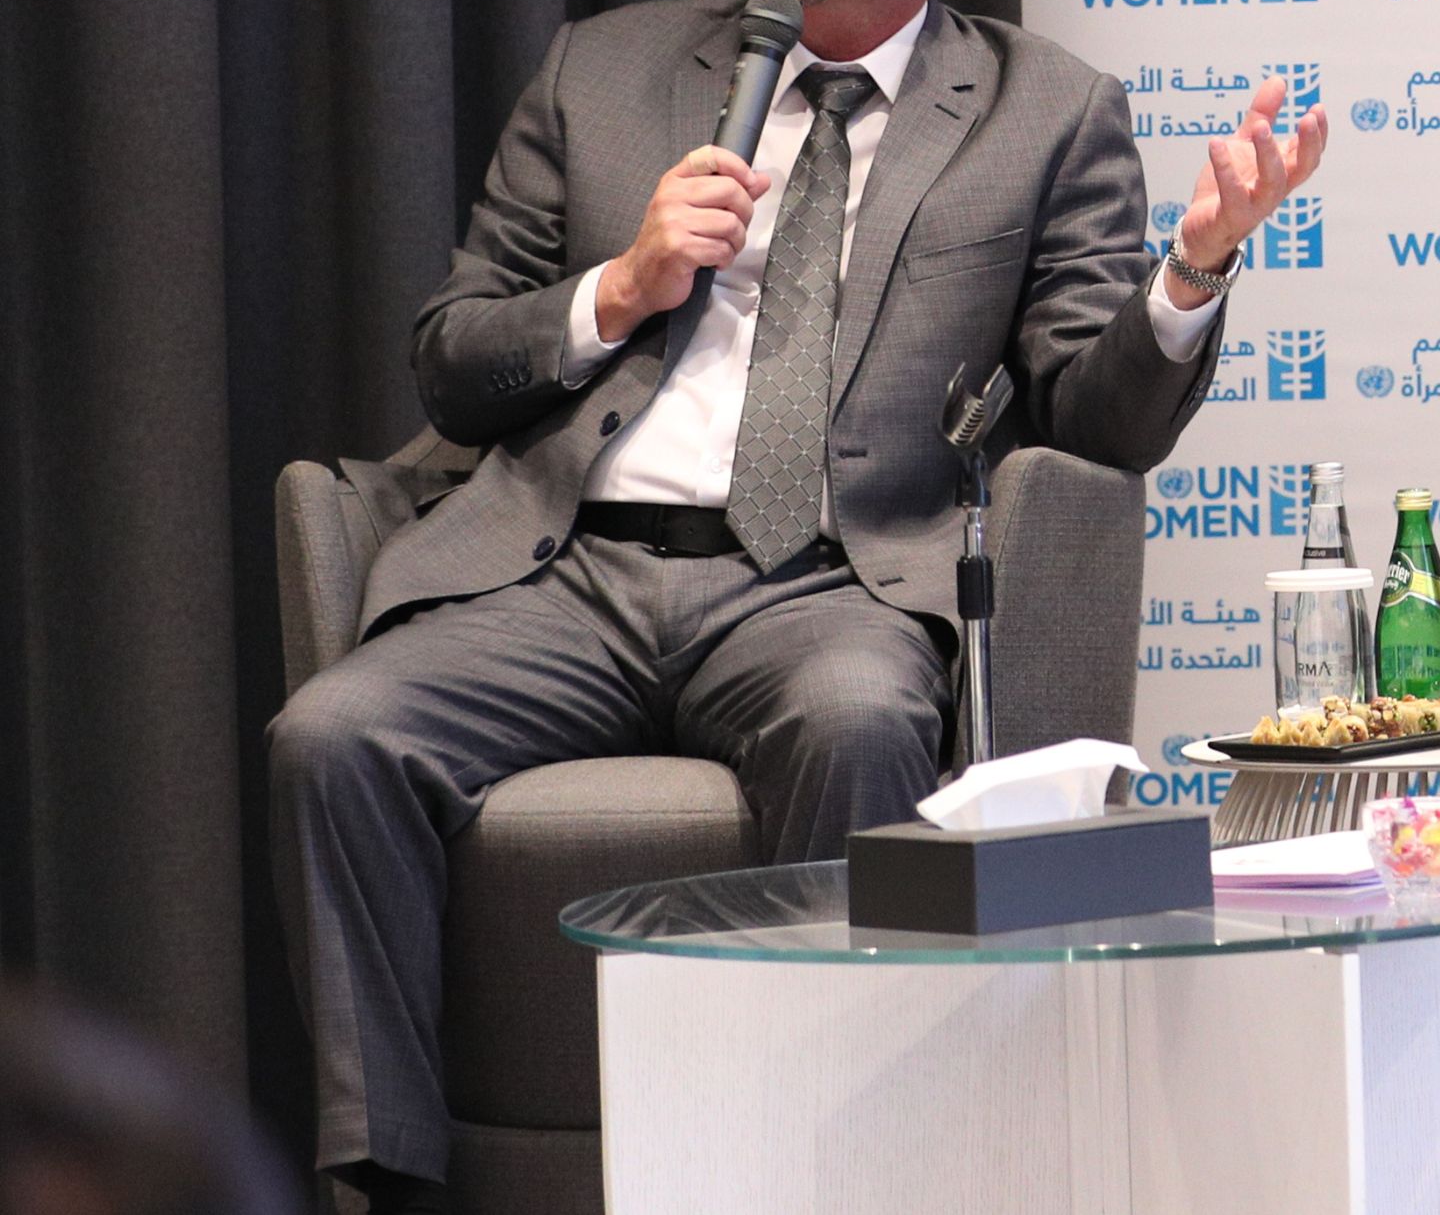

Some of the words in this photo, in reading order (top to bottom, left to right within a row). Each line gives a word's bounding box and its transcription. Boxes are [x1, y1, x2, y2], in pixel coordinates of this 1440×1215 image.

[1122, 65, 1163, 93] الأم
[1170, 66, 1250, 98] هيئة
[1197, 465, 1260, 500] UN
[1143, 503, 1261, 540] OMEN
[1180, 598, 1261, 632] هيئة
[1169, 644, 1262, 670] المتحدة
